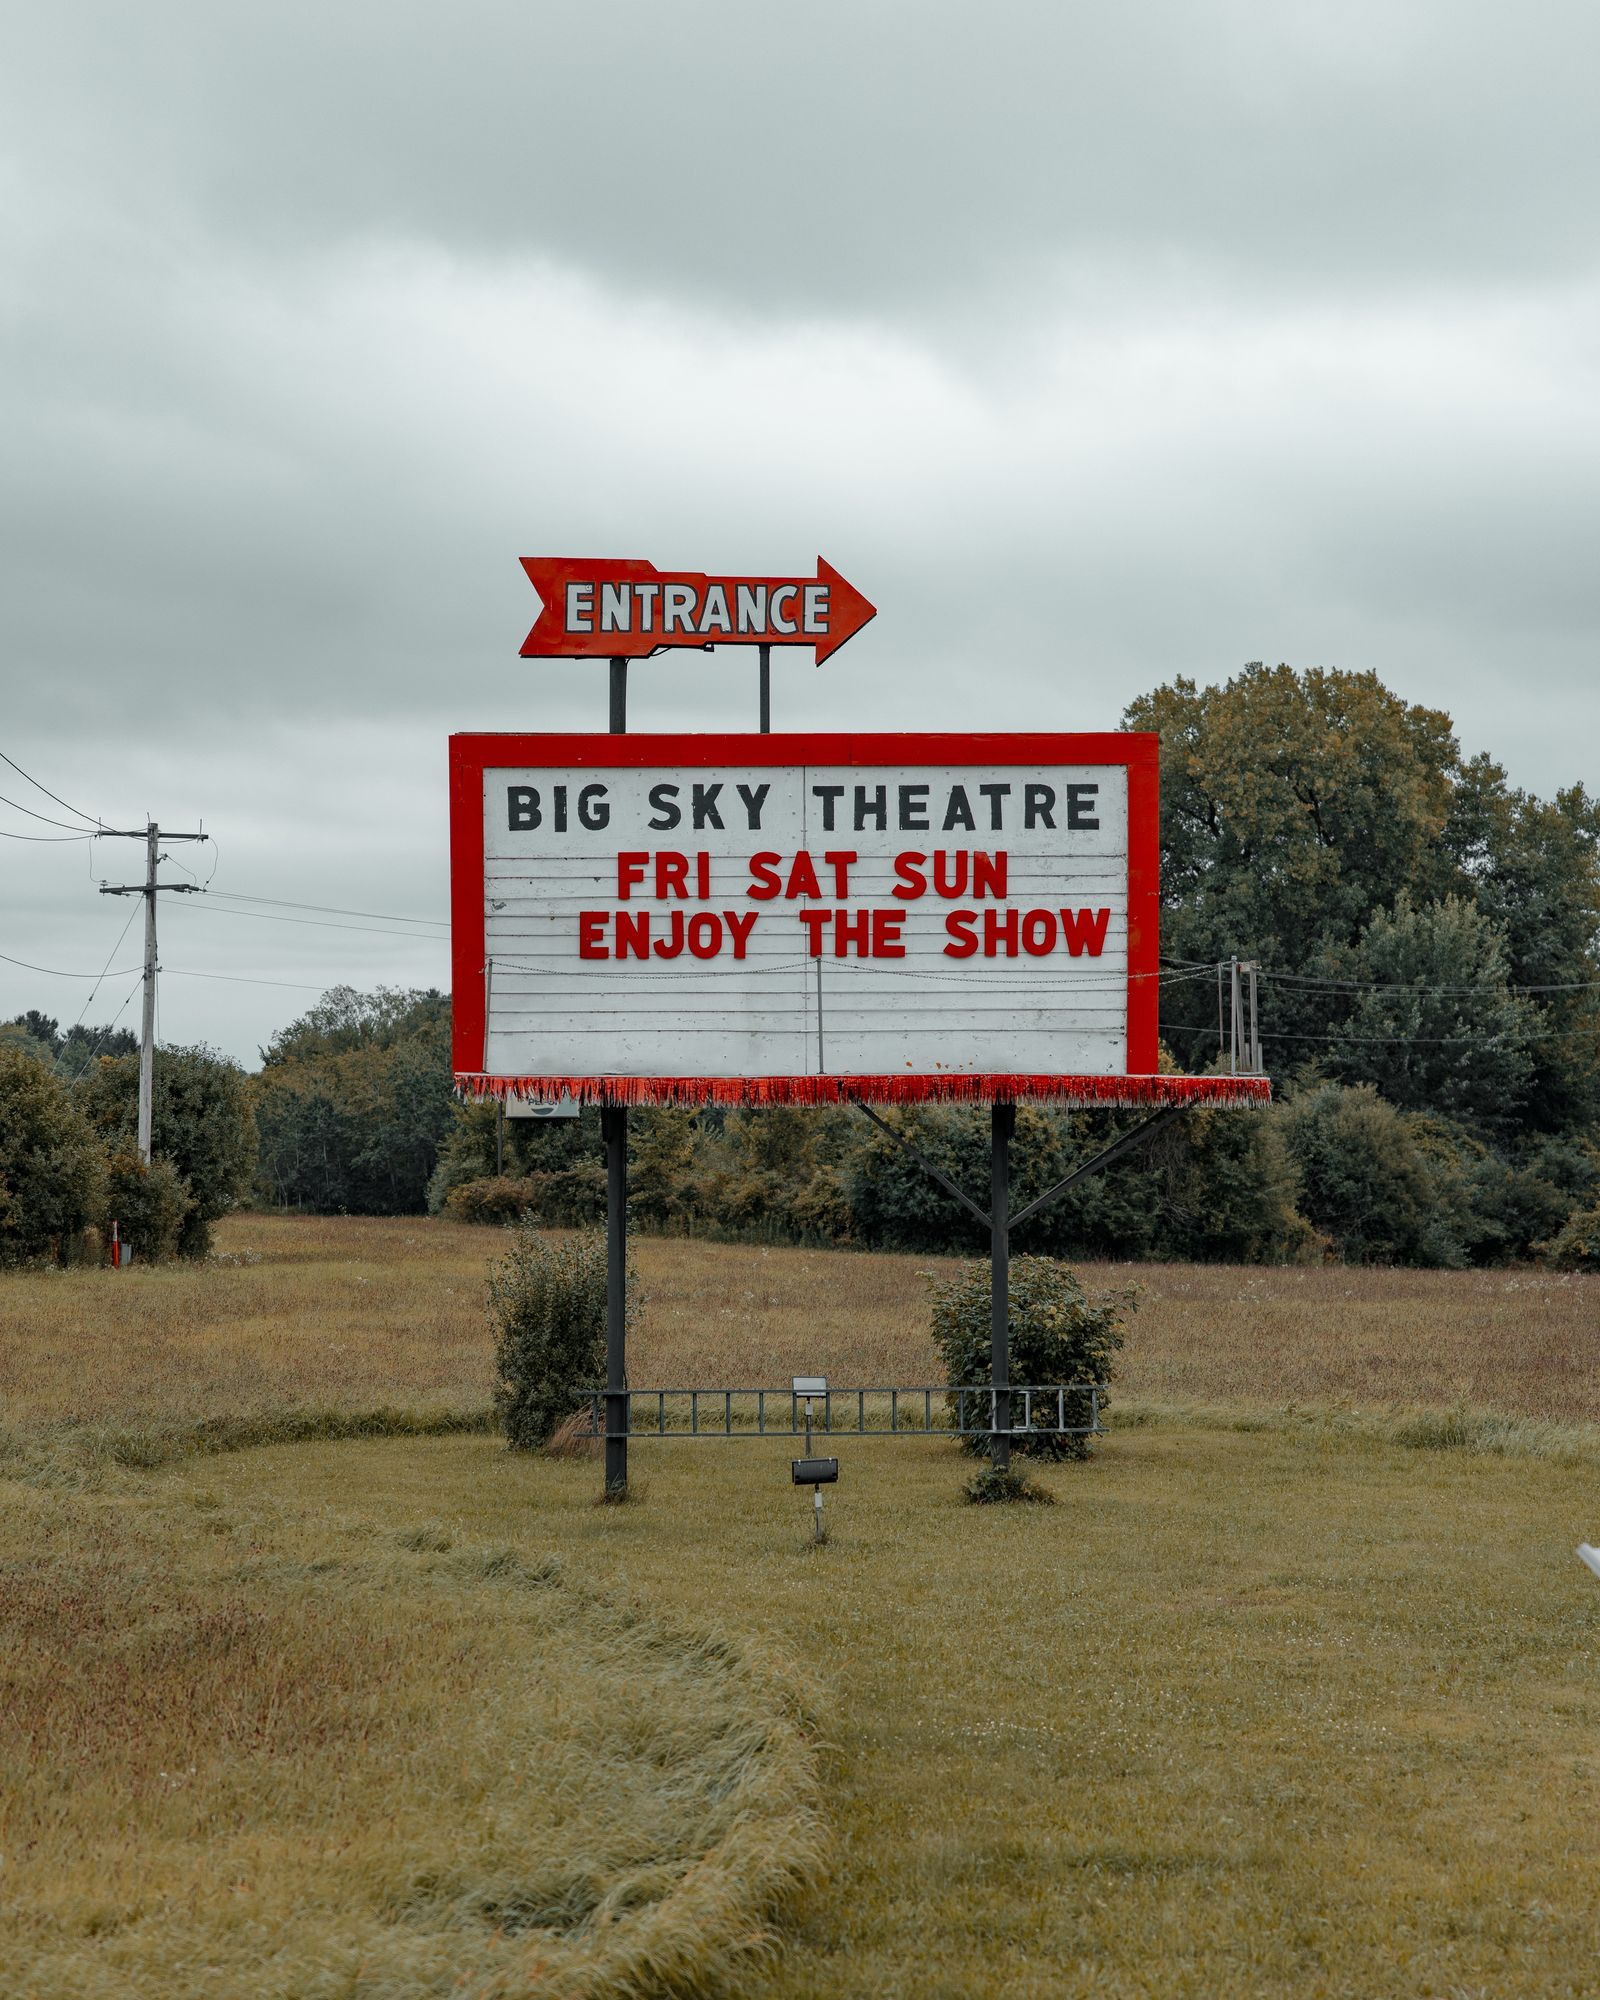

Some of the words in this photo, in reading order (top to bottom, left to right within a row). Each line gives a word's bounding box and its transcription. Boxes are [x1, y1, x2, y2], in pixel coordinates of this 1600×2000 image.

[564, 581, 831, 635] ENTRANCE
[507, 783, 611, 833] BIG
[647, 783, 771, 831] SKY
[812, 783, 1100, 832] THEATRE
[617, 851, 710, 901] FRI
[746, 850, 858, 901] SAT
[891, 850, 1008, 900] SUN
[579, 910, 759, 960] ENJOY
[799, 909, 907, 959] THE
[943, 908, 1111, 959] SHOW
